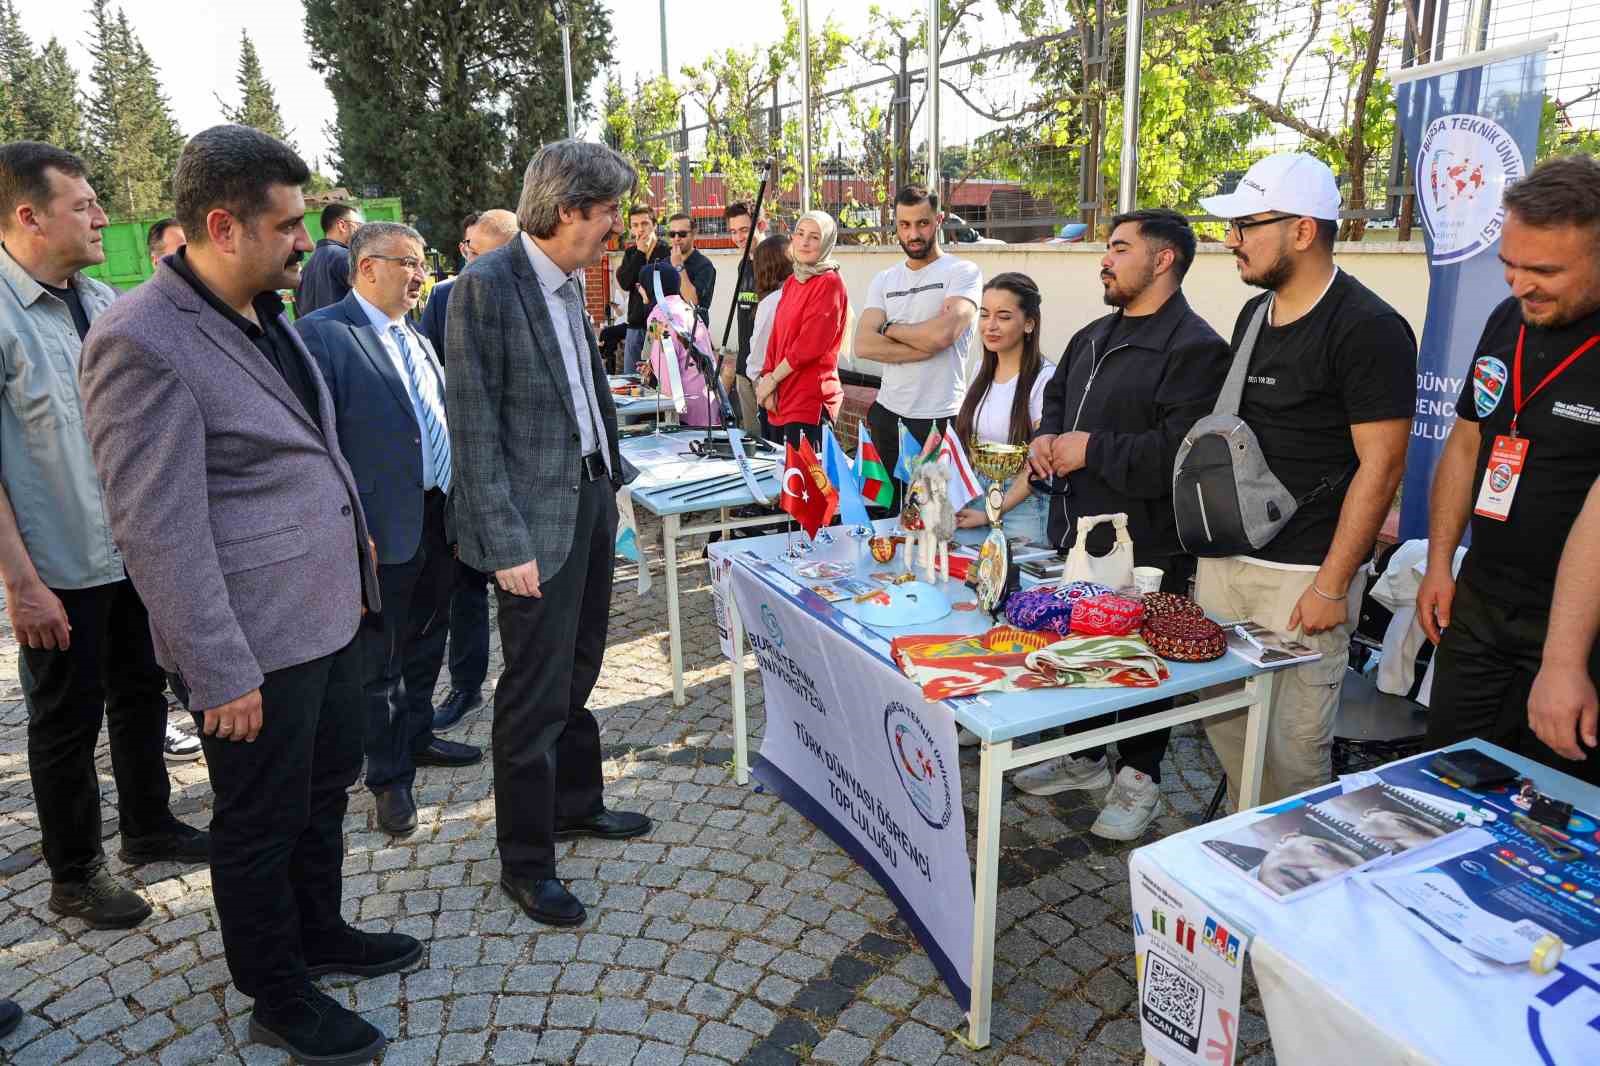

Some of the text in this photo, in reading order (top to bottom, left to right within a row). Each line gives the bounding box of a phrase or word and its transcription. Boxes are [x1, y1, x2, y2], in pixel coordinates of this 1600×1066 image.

[1423, 120, 1447, 153] BURSA
[1451, 117, 1501, 146] TEKNİK
[793, 719, 932, 883] TÜRK DÜNYASI ÖĞRENCİ
[828, 778, 898, 869] TOPLULUĞU
[1147, 1011, 1193, 1047] SCAN ME
